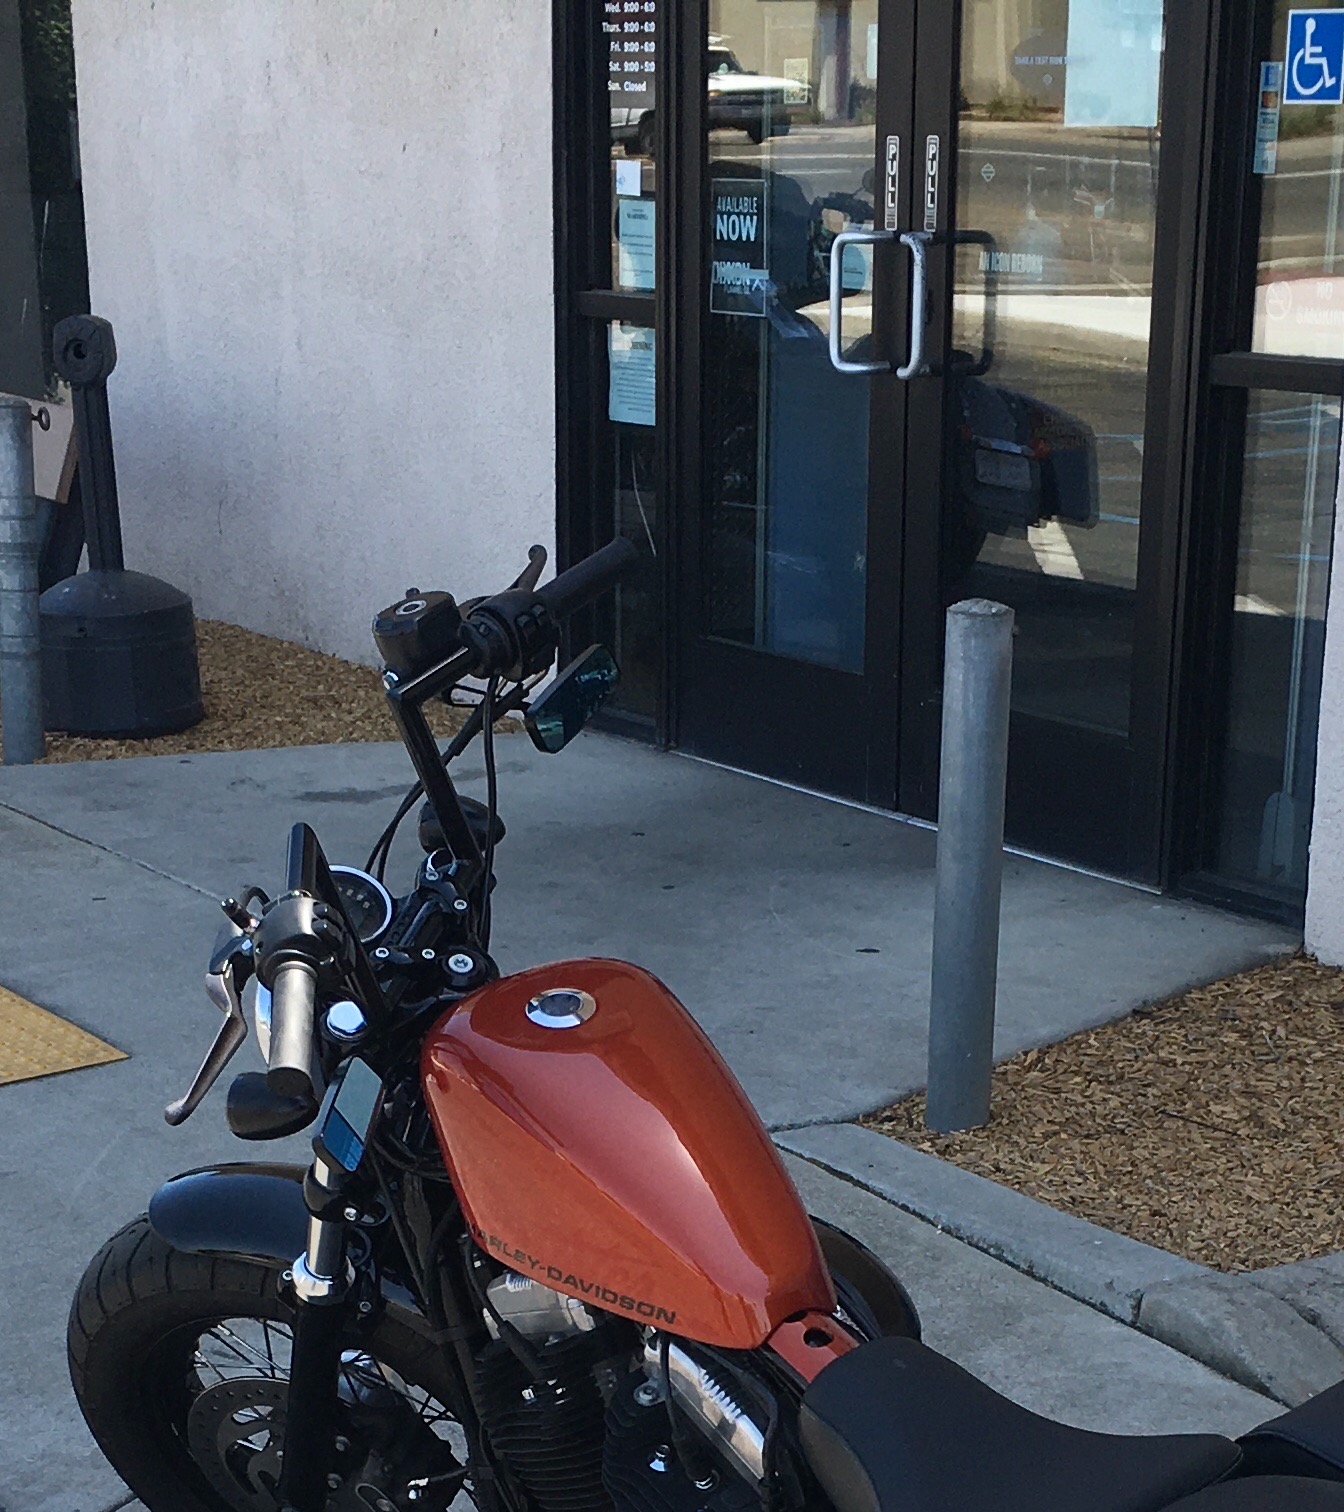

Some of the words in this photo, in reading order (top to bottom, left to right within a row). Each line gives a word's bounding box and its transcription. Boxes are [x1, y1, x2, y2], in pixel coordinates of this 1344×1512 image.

[604, 2, 621, 12] Wed.
[624, 2, 639, 12] 9:00
[602, 22, 621, 32] Thurs.
[624, 22, 639, 32] 9:00
[610, 41, 621, 51] Fri.
[624, 41, 639, 51] 9:00
[609, 61, 621, 71] Sat.
[624, 61, 639, 71] 9:00
[608, 81, 621, 91] Sun.
[624, 81, 647, 91] Closed
[887, 144, 896, 207] PULL
[927, 144, 936, 207] PULL
[716, 197, 757, 213] AVAILABLE
[716, 214, 757, 242] NOW
[480, 1230, 676, 1325] ARLEY-DAVIDSON
